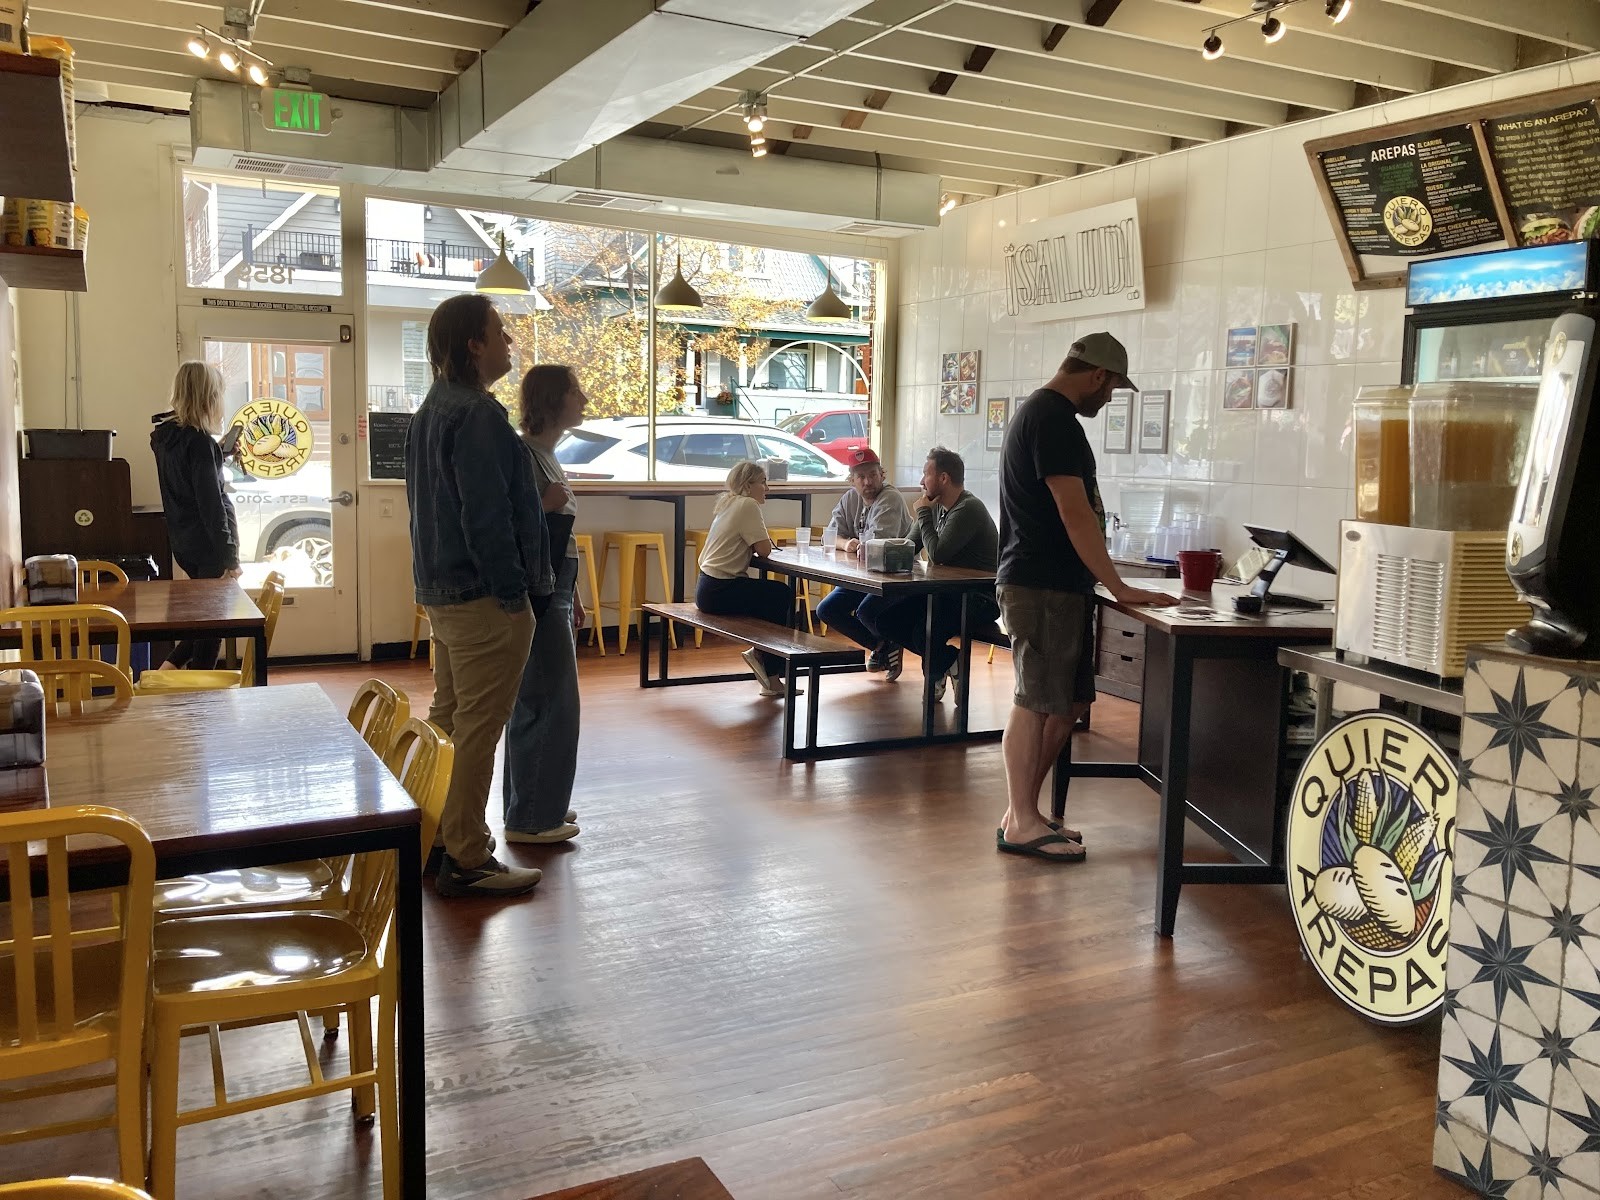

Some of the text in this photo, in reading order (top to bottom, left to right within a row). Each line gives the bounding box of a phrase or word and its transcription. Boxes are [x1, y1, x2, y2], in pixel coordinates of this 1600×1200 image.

[274, 91, 322, 130] EXIT
[1498, 107, 1588, 131] WHAT IS AN AREPA?
[1577, 119, 1595, 128] bread
[1371, 144, 1416, 163] AREPAS
[1426, 184, 1444, 192] QUESO
[1385, 198, 1428, 219] QUIERO
[1390, 224, 1430, 245] AREPAS
[1004, 217, 1140, 316] ¡SALUD!
